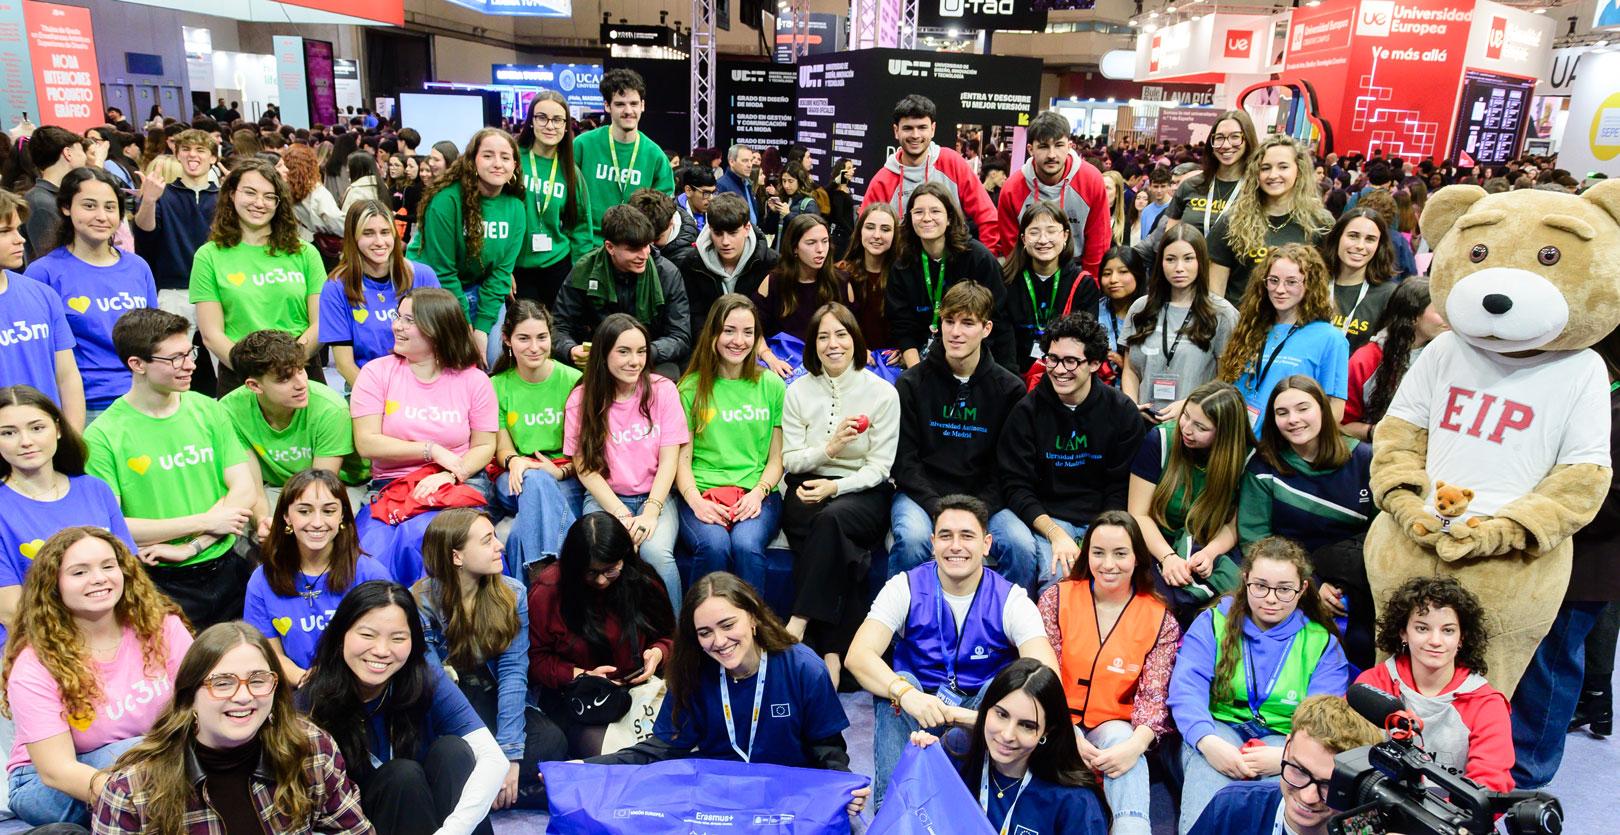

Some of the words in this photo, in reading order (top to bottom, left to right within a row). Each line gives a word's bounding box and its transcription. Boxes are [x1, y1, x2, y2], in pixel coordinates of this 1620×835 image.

[1364, 12, 1387, 25] ue
[1393, 5, 1473, 22] Universidad
[1391, 20, 1447, 36] Europea
[1228, 38, 1249, 50] ue
[1391, 48, 1420, 60] más
[1422, 48, 1448, 62] allá
[960, 92, 987, 101] ¡ENTRA
[988, 93, 994, 101] Y
[994, 94, 1031, 103] DESCUBRE
[1163, 88, 1214, 105] LAVAPIÉ
[961, 100, 972, 108] TU
[972, 101, 996, 110] MEJOR
[996, 101, 1031, 111] VERSIÓN!
[252, 268, 305, 287] uc3m
[96, 292, 148, 312] uc3m
[0, 320, 49, 346] uc3m
[404, 405, 462, 423] uc3m
[722, 404, 770, 422] uc3m
[1439, 386, 1535, 445] EIP
[611, 423, 661, 445] uc3m
[951, 430, 972, 438] Madrid
[300, 609, 337, 632] uc3
[695, 811, 734, 822] Erasmus+
